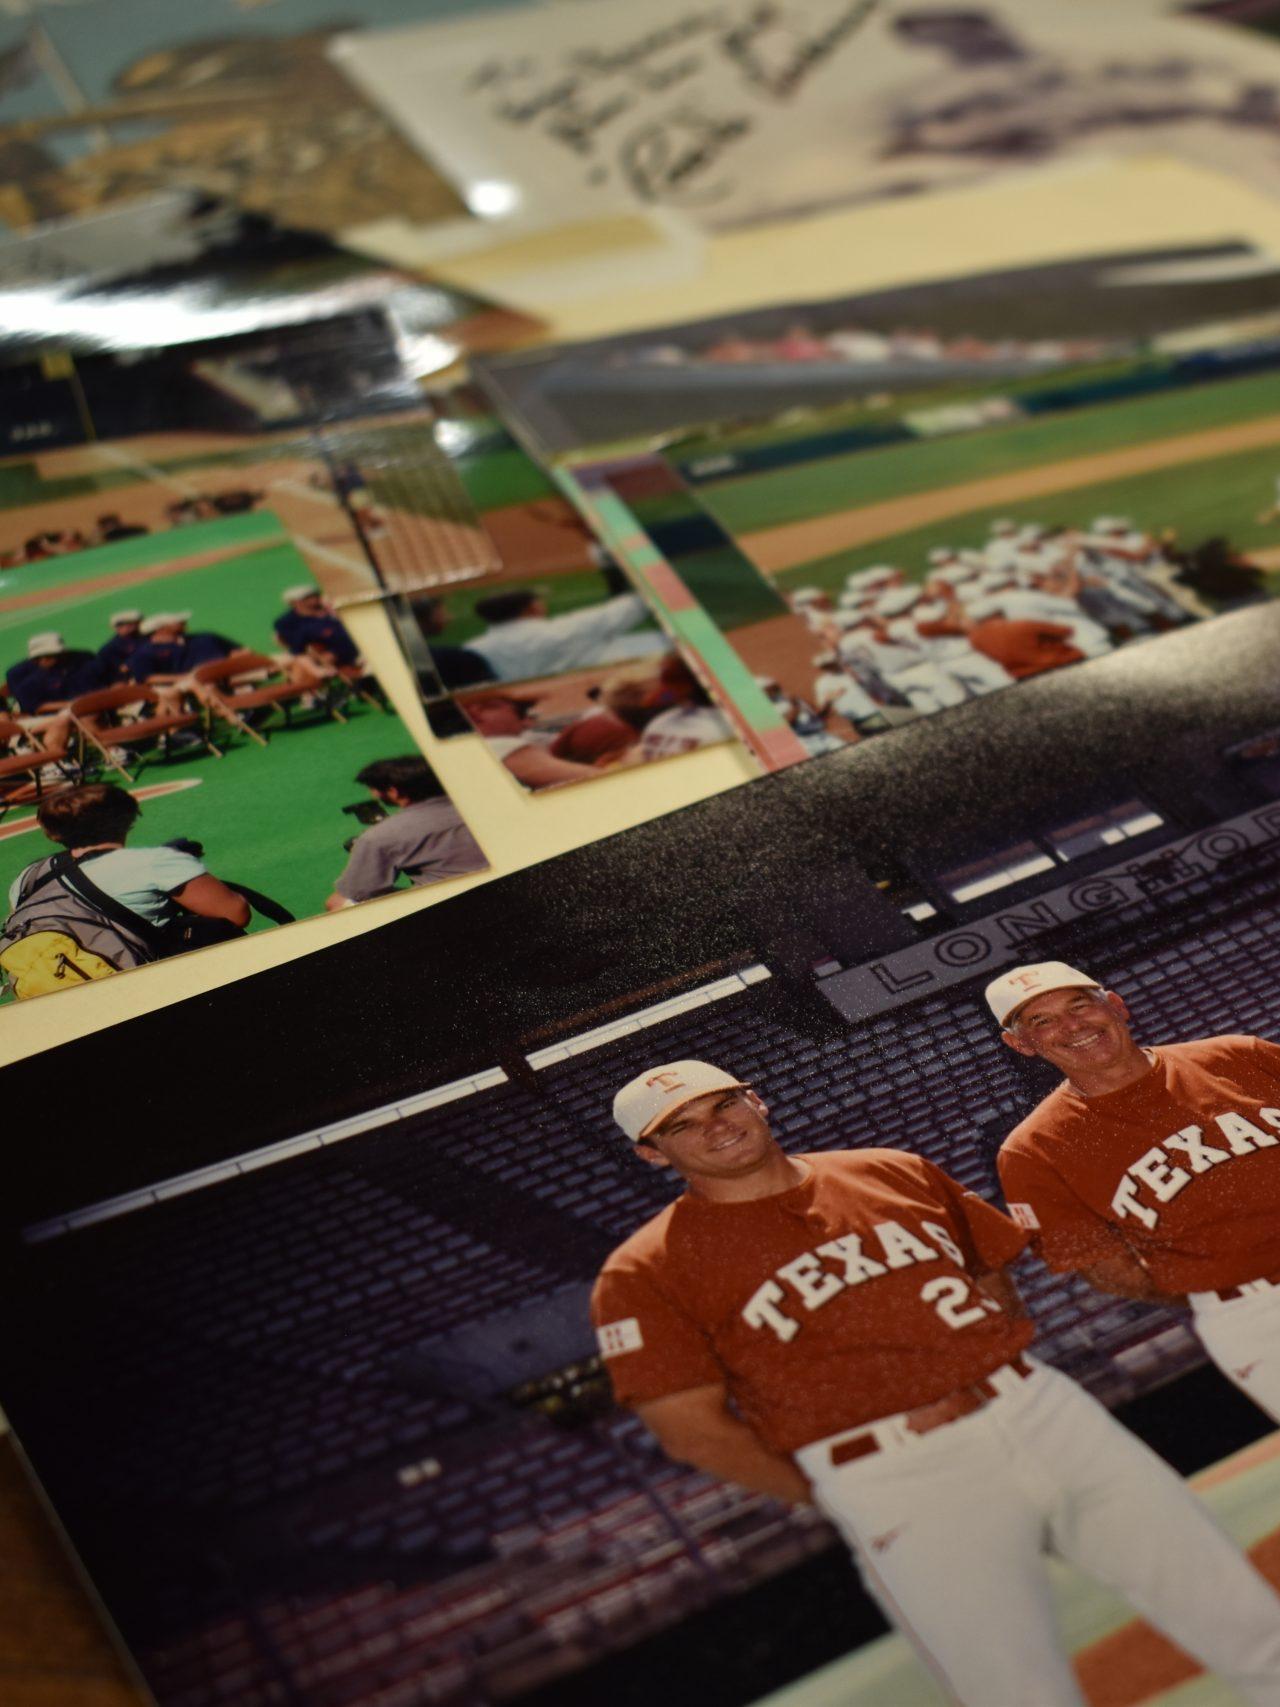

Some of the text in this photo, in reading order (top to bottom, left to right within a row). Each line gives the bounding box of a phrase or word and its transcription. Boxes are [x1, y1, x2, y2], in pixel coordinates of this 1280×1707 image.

[1008, 970, 1042, 992] T
[646, 1071, 686, 1094] T
[741, 1220, 965, 1342] TEXAS
[919, 1275, 1001, 1330] 2
